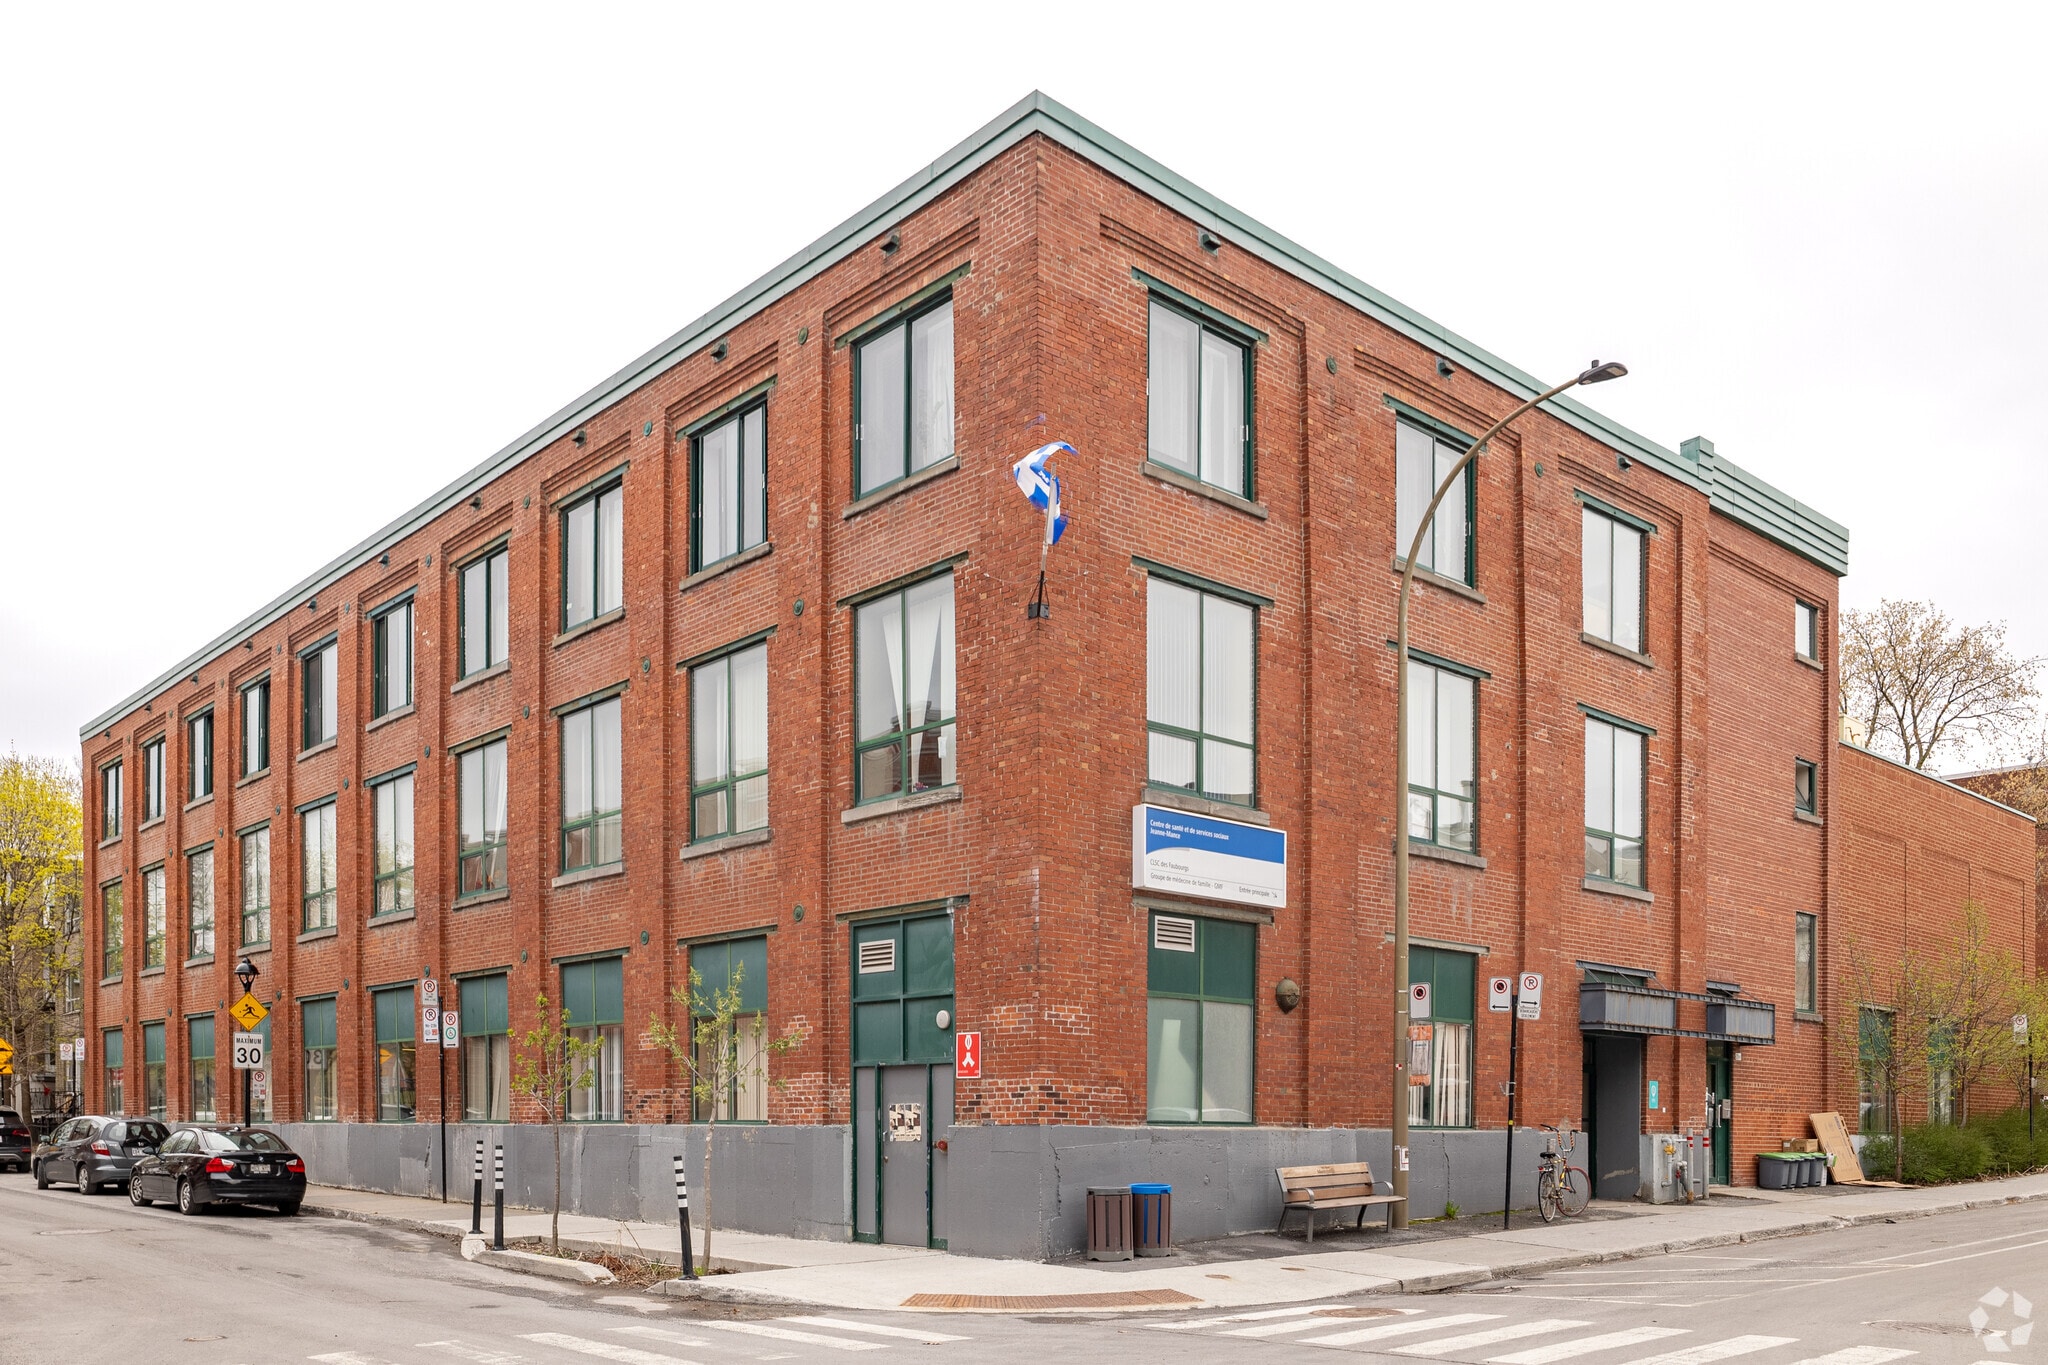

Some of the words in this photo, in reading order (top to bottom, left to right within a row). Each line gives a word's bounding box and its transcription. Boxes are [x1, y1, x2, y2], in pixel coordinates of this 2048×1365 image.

[1150, 819, 1164, 828] Centre
[1172, 824, 1183, 832] santé
[1196, 829, 1213, 837] services
[1213, 832, 1229, 840] sociaux
[1150, 858, 1160, 867] CLSC
[1168, 862, 1189, 872] Faubourgs
[1150, 872, 1166, 881] Groupe
[1172, 876, 1191, 885] médecine
[236, 1047, 261, 1064] 30
